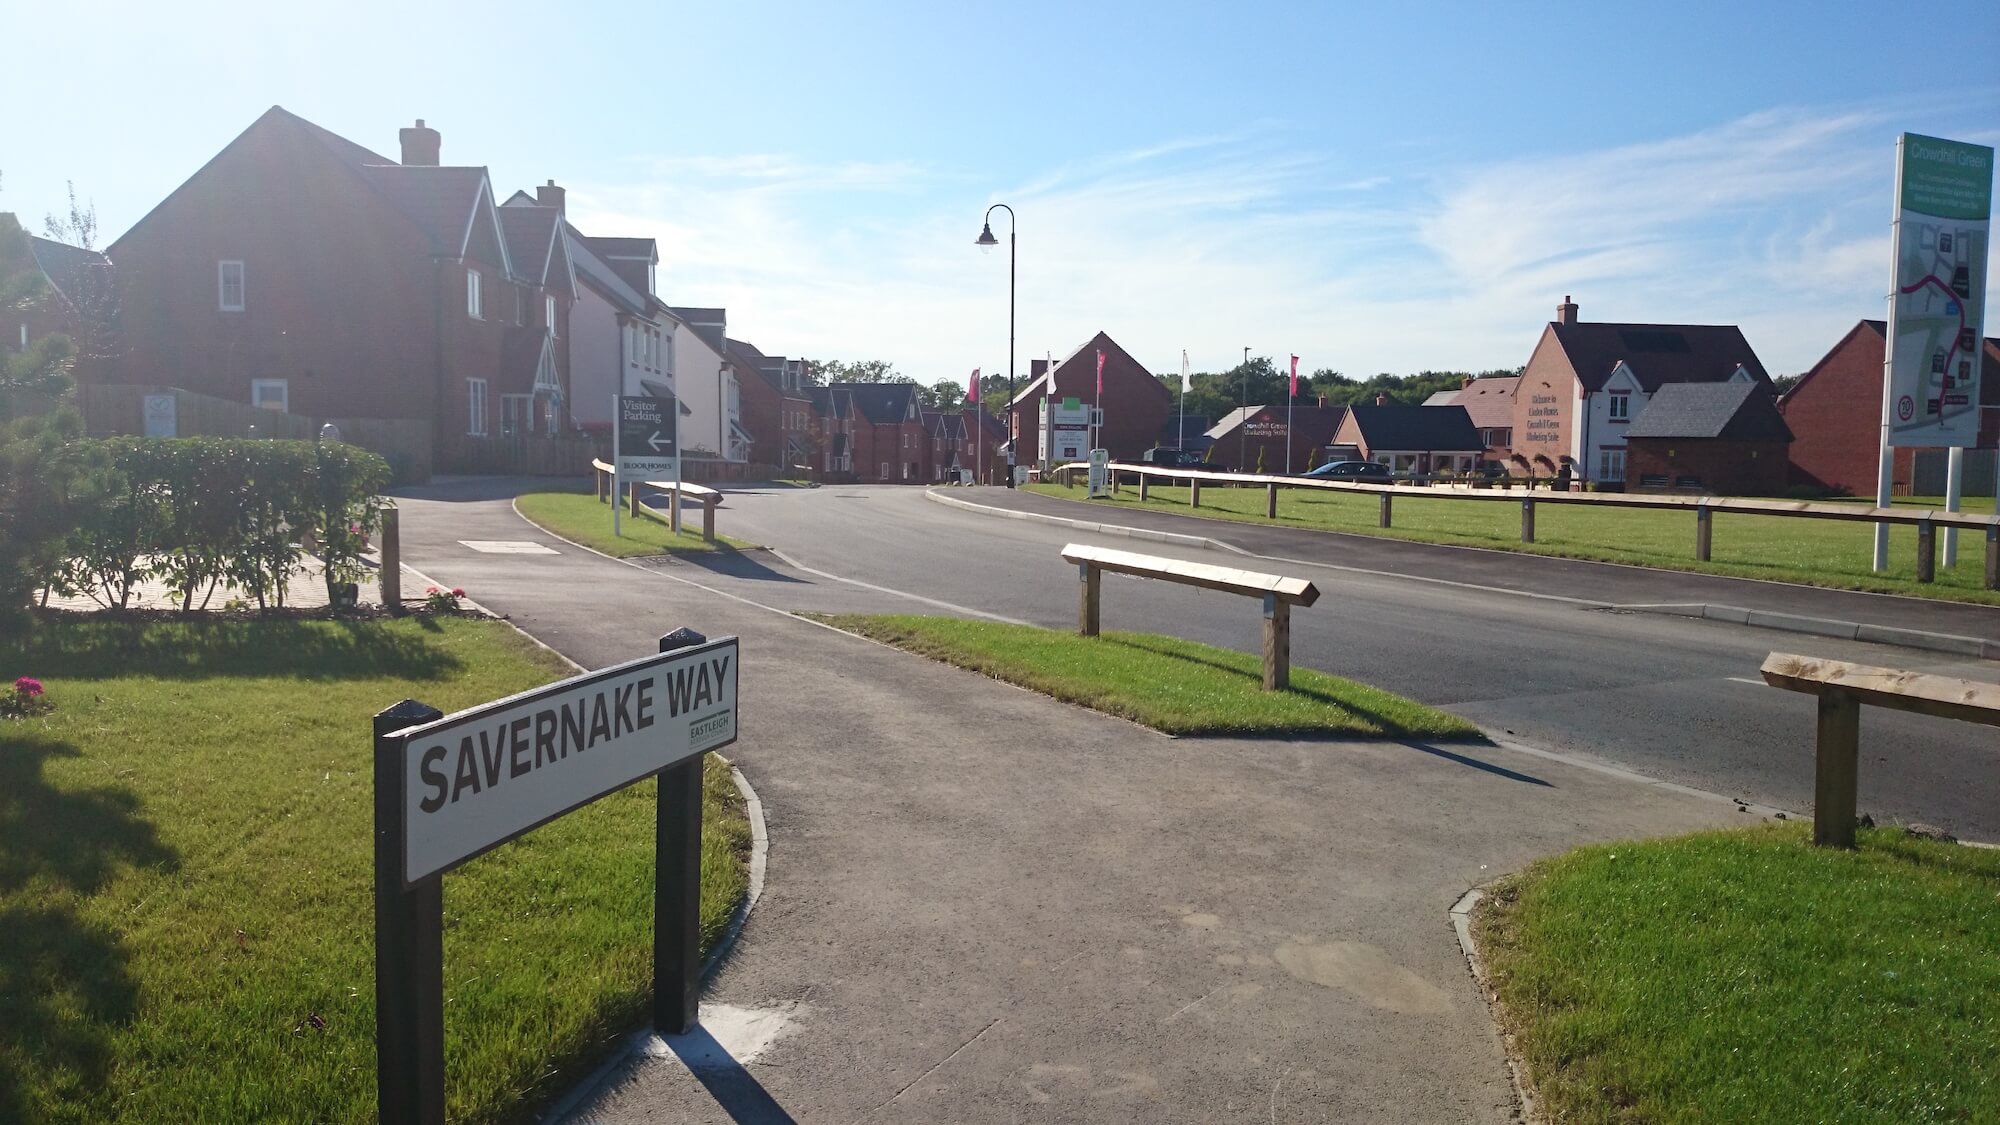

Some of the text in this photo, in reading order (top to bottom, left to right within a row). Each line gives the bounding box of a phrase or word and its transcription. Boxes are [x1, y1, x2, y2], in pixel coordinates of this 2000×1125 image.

[1958, 151, 1986, 168] Green
[623, 400, 657, 410] Visitor
[624, 410, 662, 423] Parking
[648, 462, 672, 470] HOMES
[419, 656, 730, 813] SAVERNAKE WAY
[690, 716, 729, 739] EASTLEIGH
